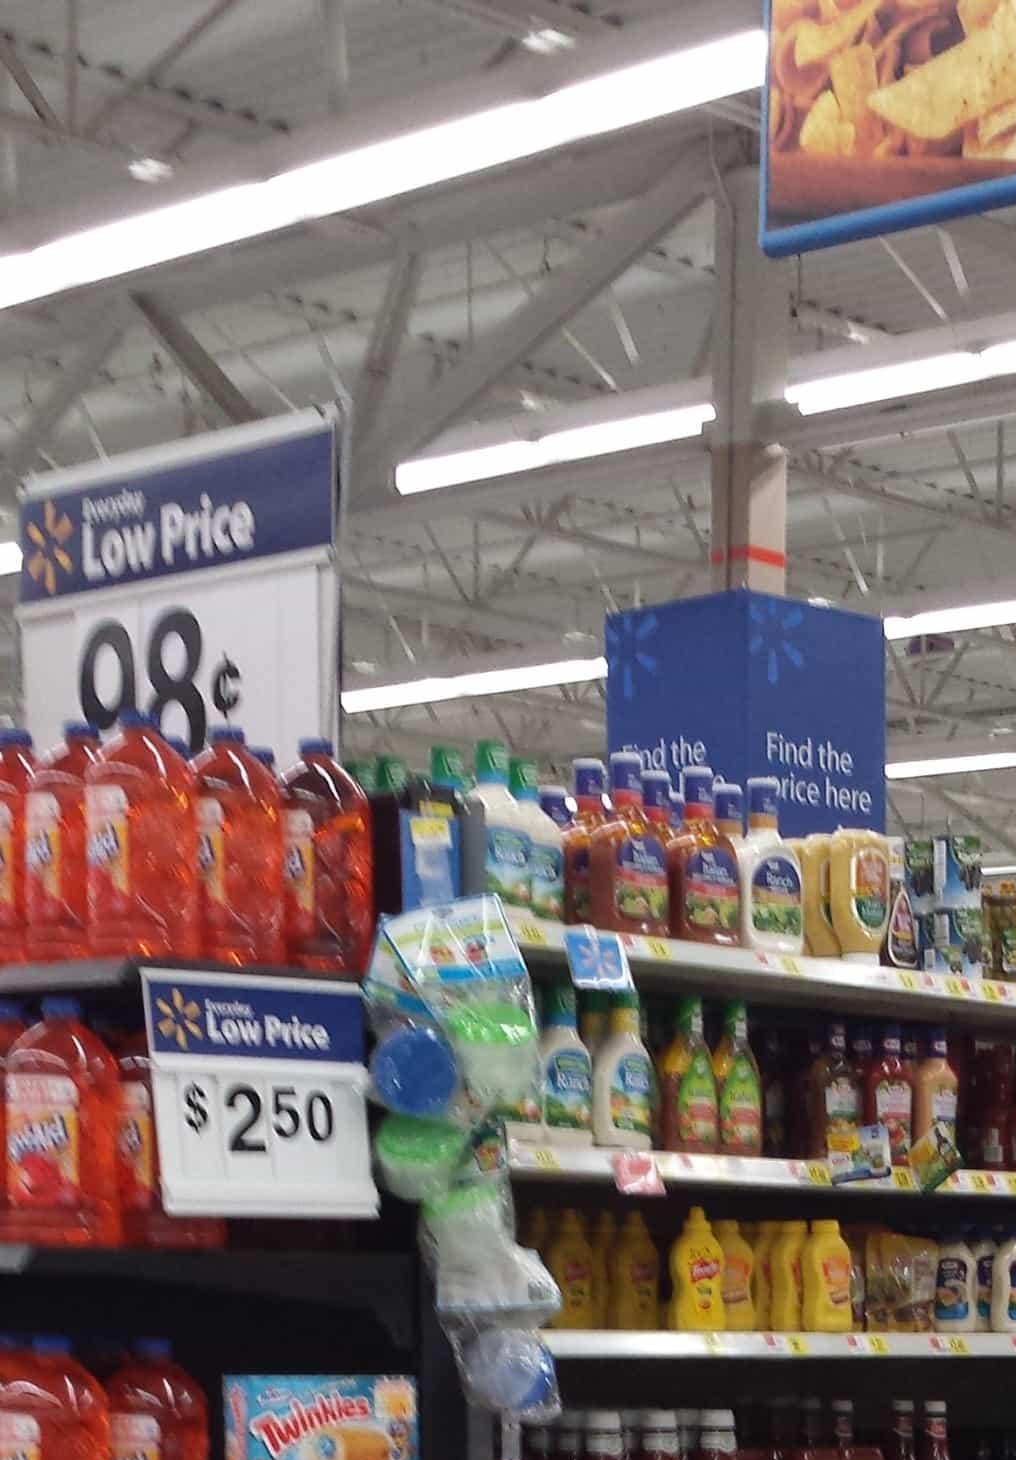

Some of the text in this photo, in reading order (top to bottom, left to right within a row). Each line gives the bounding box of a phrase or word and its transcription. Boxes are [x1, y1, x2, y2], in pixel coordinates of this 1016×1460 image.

[82, 491, 256, 581] Low Price
[671, 735, 707, 767] the
[766, 731, 854, 775] Find the
[825, 776, 872, 814] here
[206, 1010, 330, 1051] Low Price
[250, 1390, 371, 1458] Twinkies
